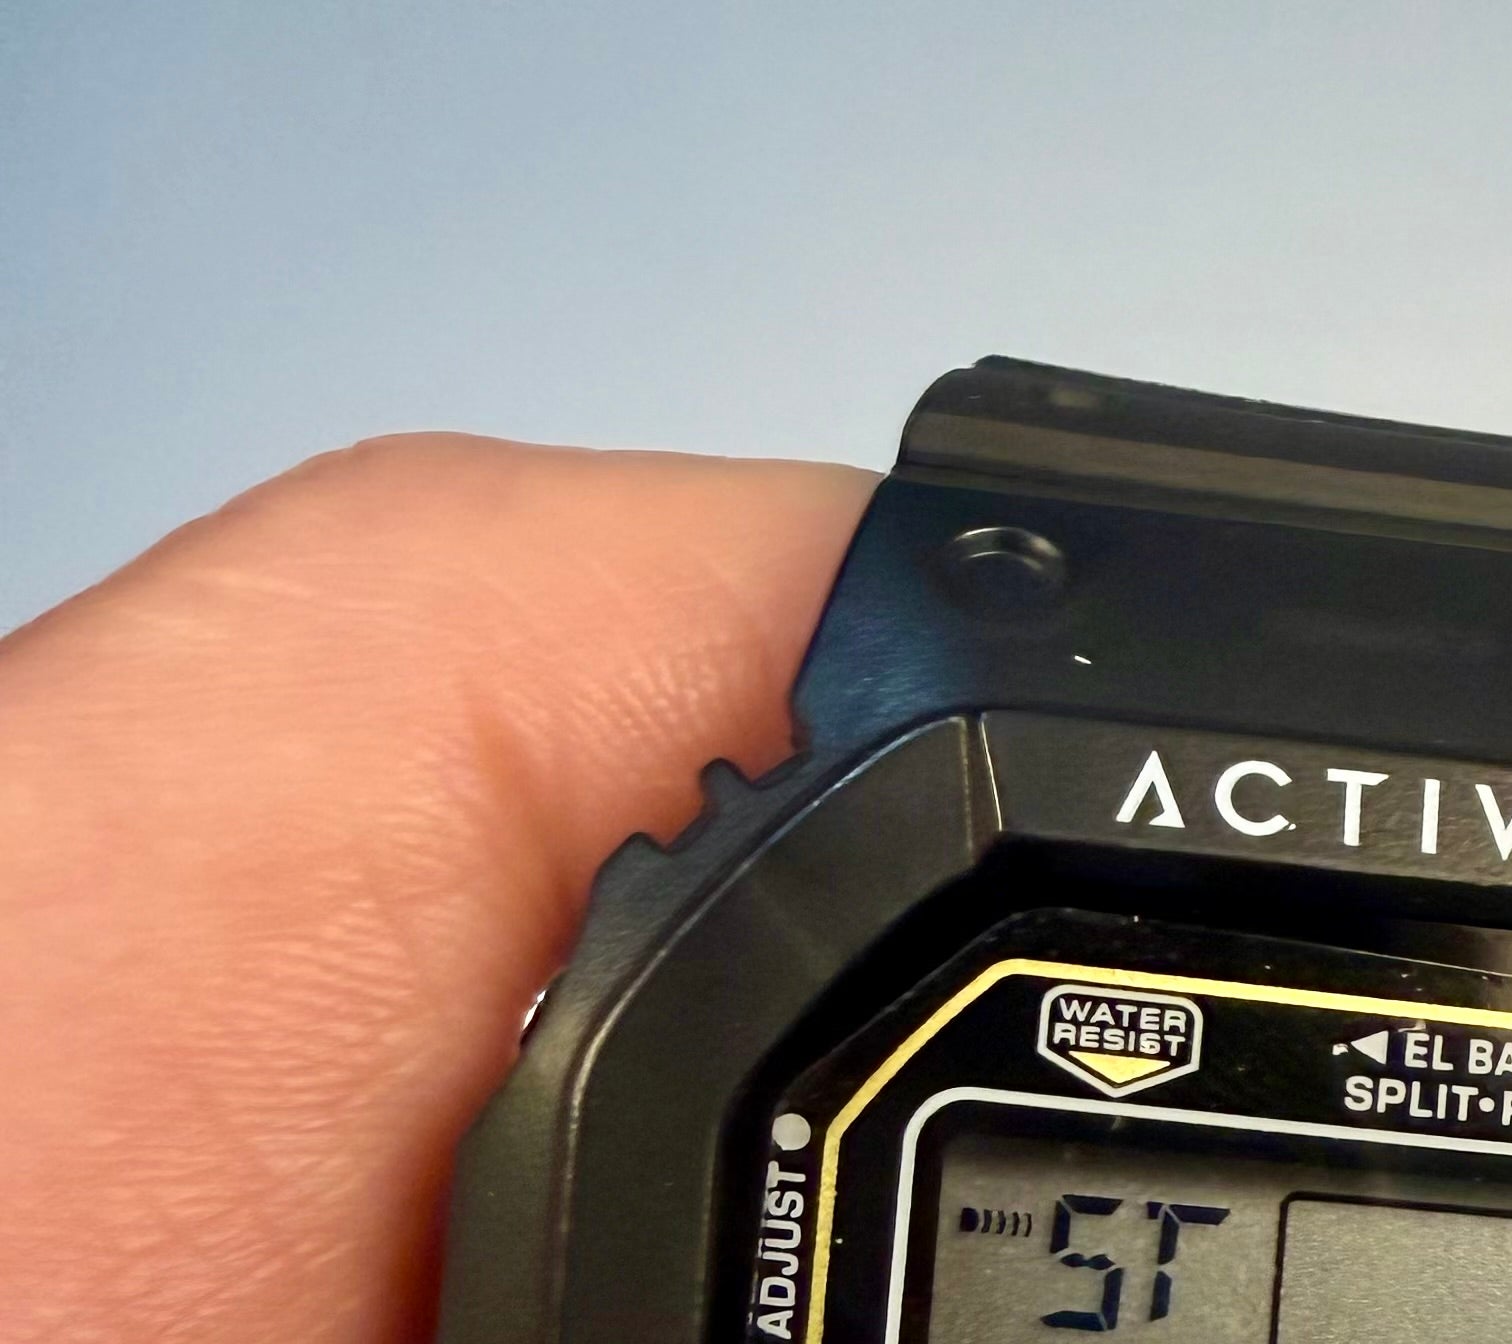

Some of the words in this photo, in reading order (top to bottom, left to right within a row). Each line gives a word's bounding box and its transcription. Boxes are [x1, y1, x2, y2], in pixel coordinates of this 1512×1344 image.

[1059, 998, 1187, 1034] WATER
[1053, 1022, 1187, 1058] RESIST
[1404, 1031, 1453, 1072] EL
[757, 1160, 806, 1340] ADJUST
[1041, 1194, 1231, 1332] ST
